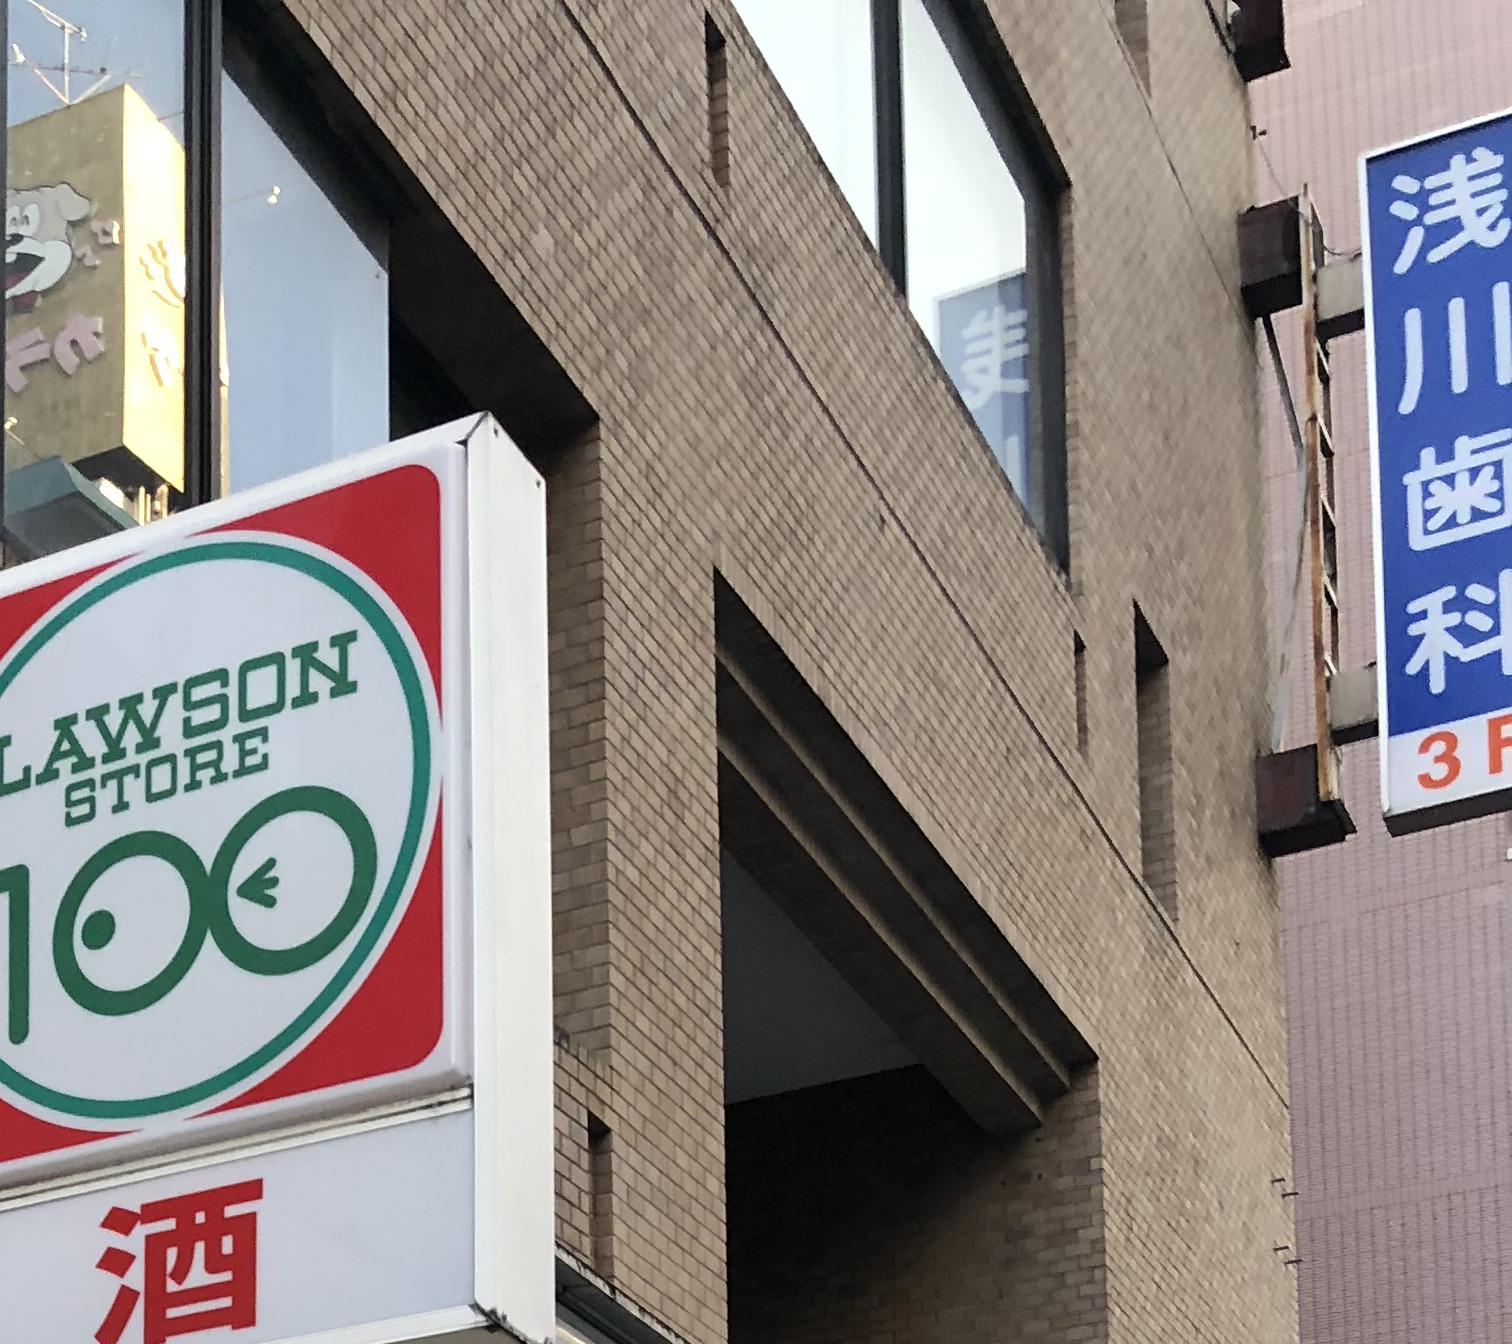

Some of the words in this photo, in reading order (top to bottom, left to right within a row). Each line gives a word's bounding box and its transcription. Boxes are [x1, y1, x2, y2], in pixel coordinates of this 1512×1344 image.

[1388, 146, 1512, 696] 浅川歯科
[64, 725, 271, 828] STORE
